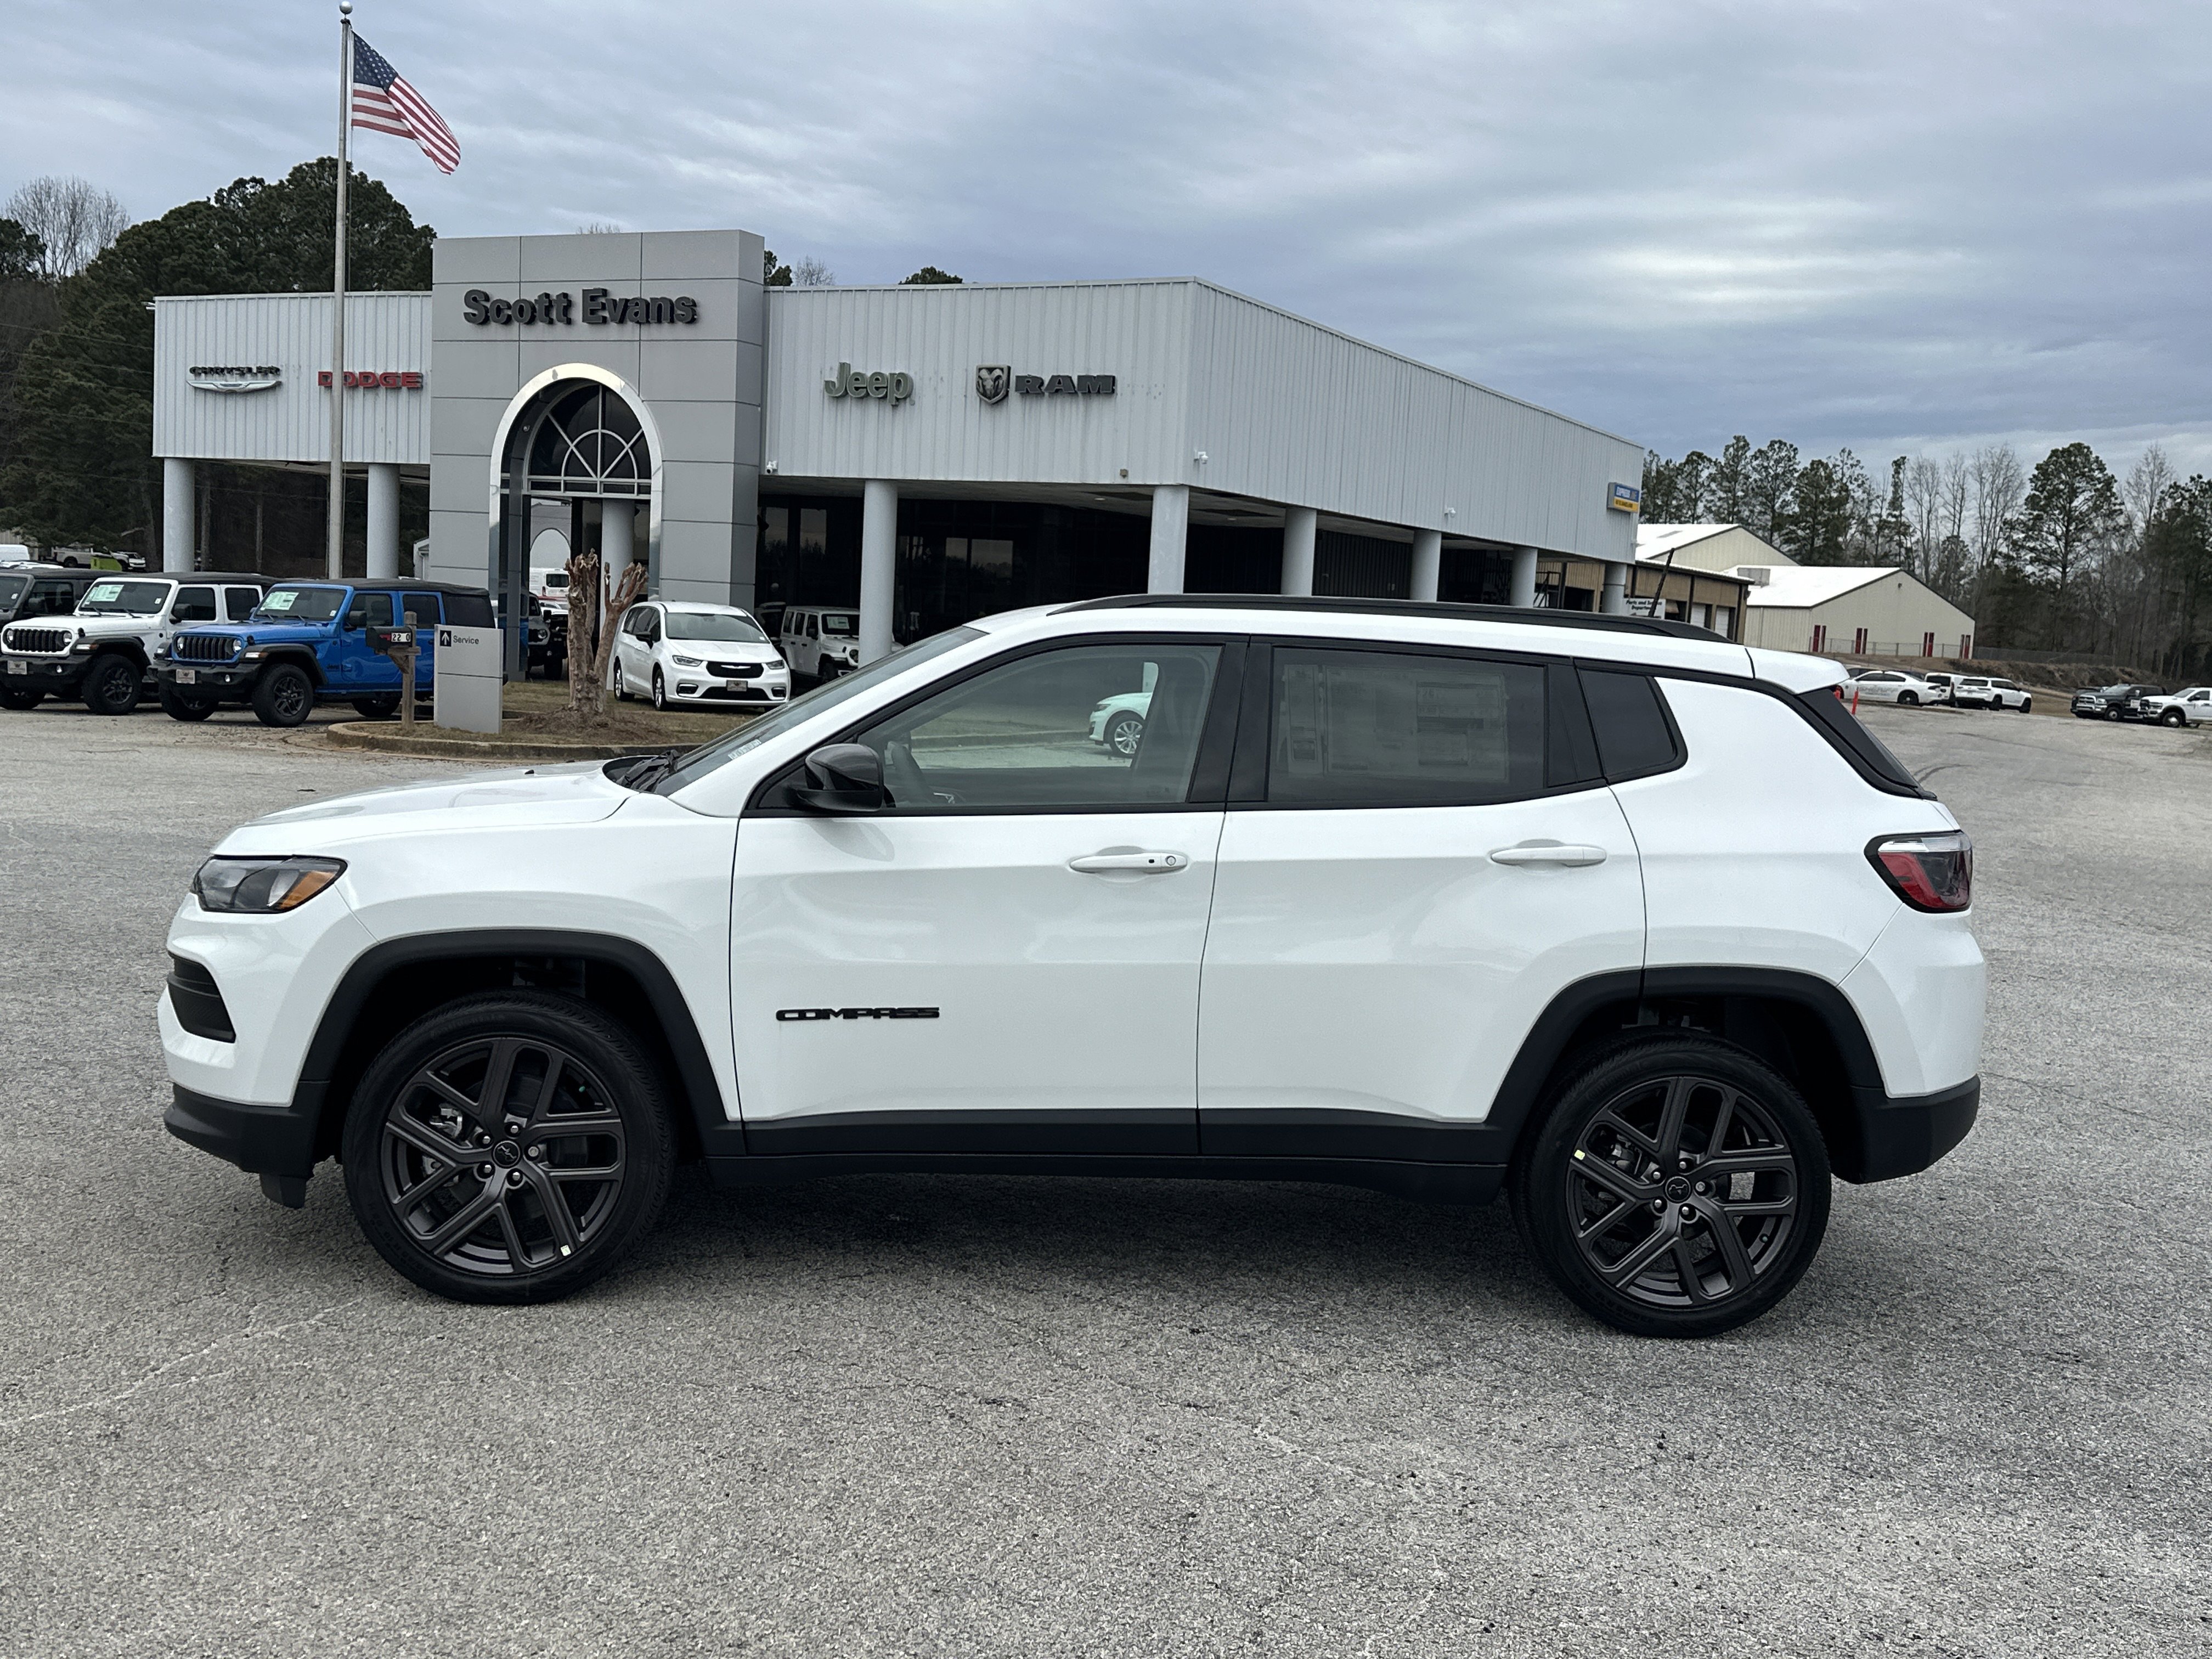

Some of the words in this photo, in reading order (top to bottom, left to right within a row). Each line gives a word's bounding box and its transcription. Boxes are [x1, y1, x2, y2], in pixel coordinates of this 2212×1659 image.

[463, 289, 572, 325] Scott
[582, 287, 697, 324] Evans
[318, 371, 422, 388] DODGE
[824, 362, 914, 405] Jeep
[1015, 374, 1116, 394] RAM
[453, 635, 479, 645] Service
[776, 1007, 940, 1021] COMPASS
